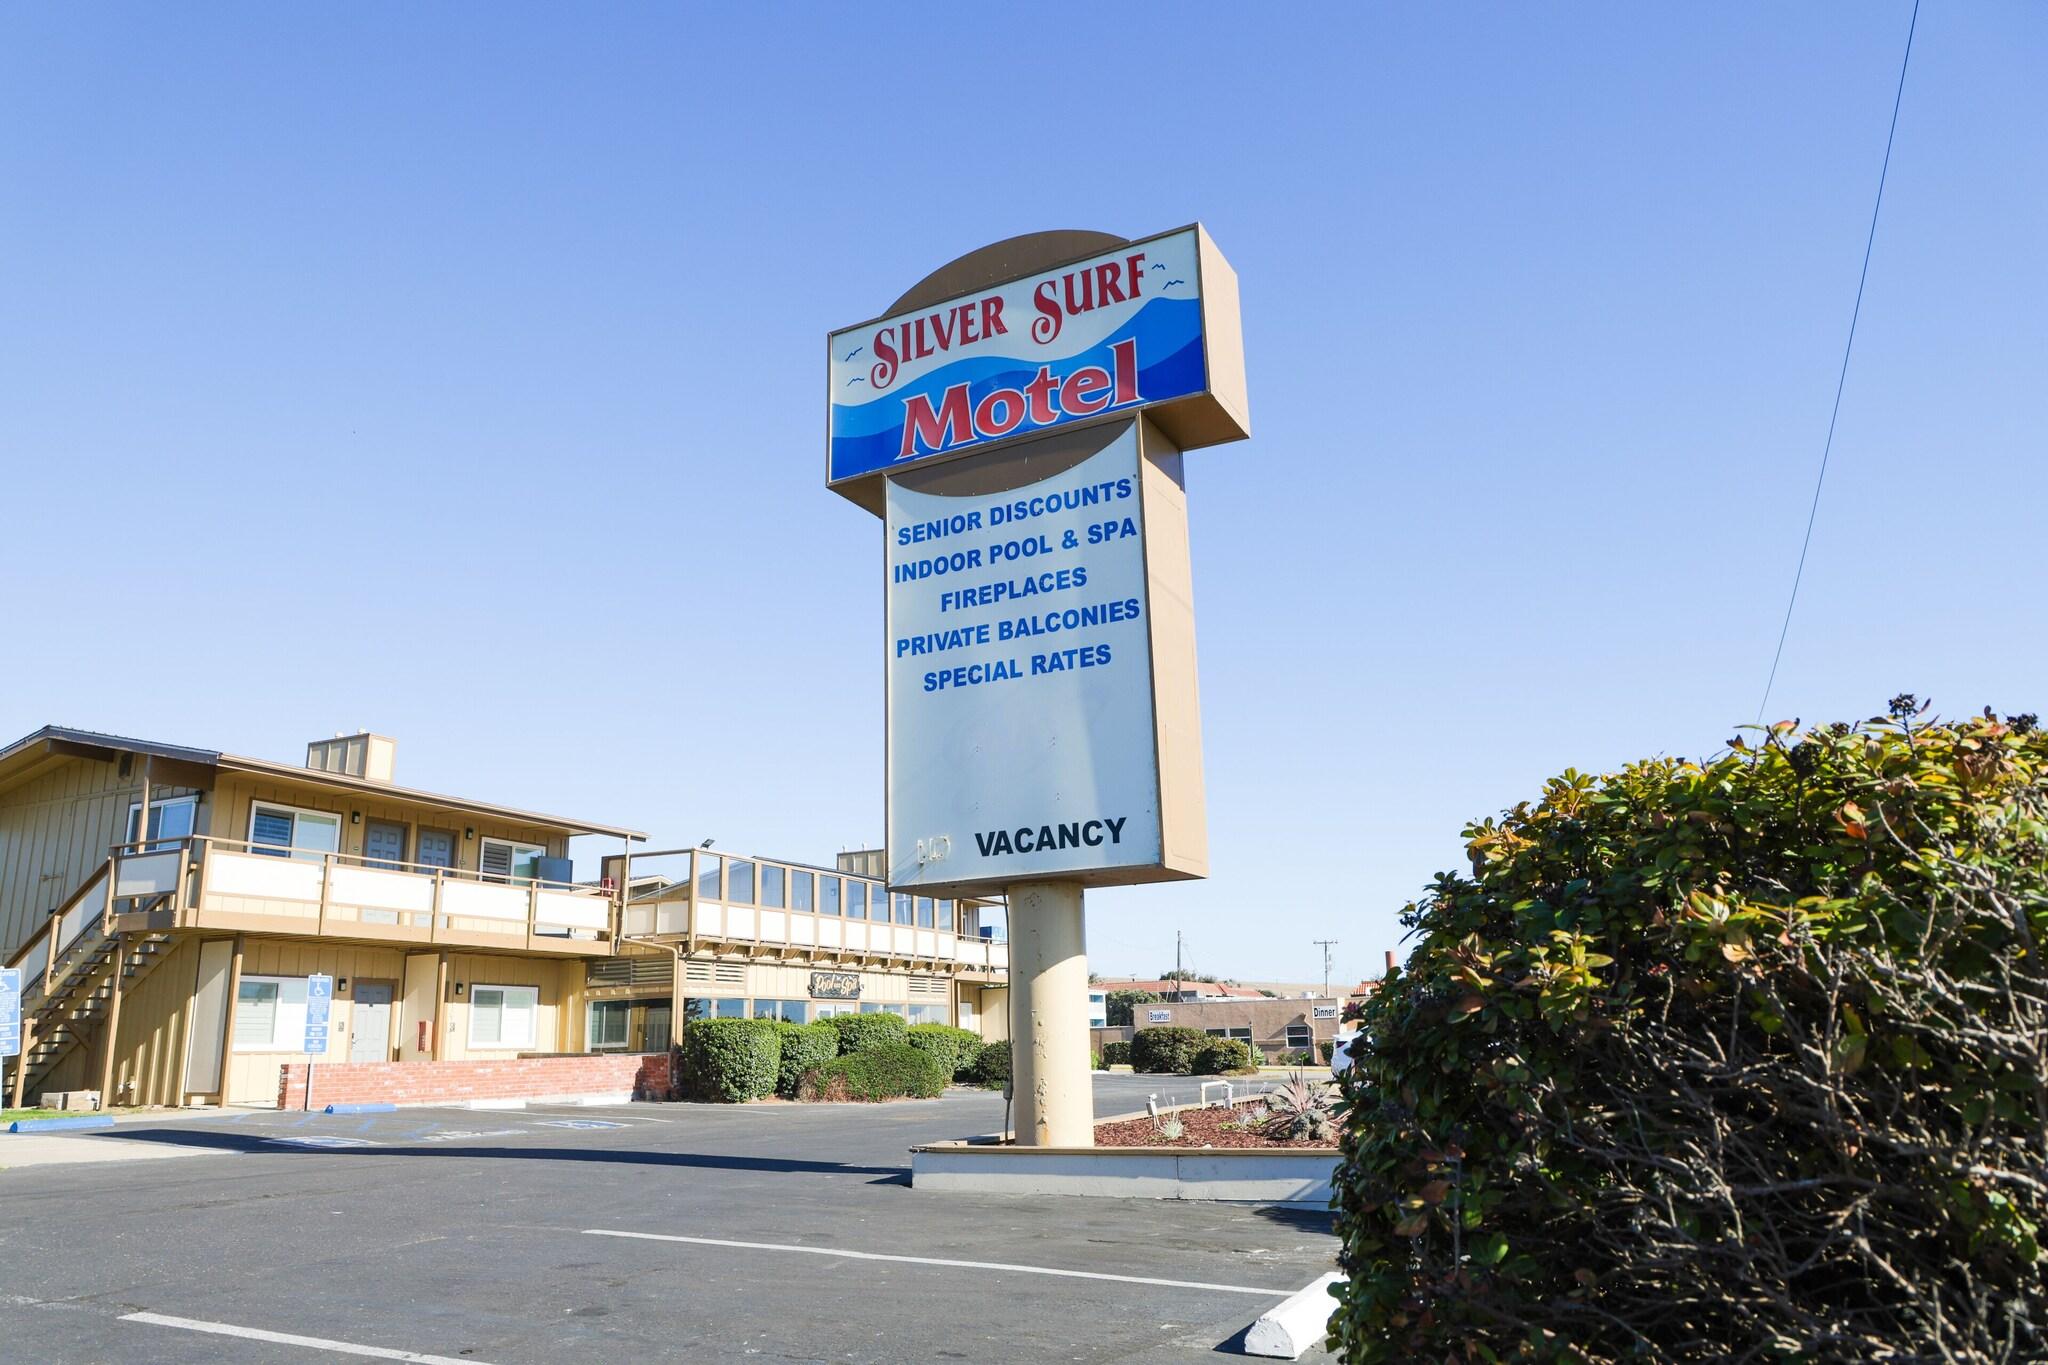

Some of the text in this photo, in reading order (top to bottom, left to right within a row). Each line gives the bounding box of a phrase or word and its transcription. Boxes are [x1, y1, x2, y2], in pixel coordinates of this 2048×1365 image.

[870, 253, 1146, 389] SILVER SURF
[895, 336, 1145, 460] Motel
[897, 478, 1132, 546] SENIOR DISCOUNTS
[894, 517, 1138, 583] INDOOR POOL & SPA
[941, 566, 1088, 612] FIREPLACES
[896, 598, 1140, 658] PRIVATE BALCONIES
[923, 644, 1112, 692] SPECIAL RATES
[974, 816, 1128, 857] VACANCY
[815, 974, 858, 996] Pool Spa
[1150, 1011, 1170, 1021] Breakfast
[1313, 1007, 1335, 1018] Dinner
